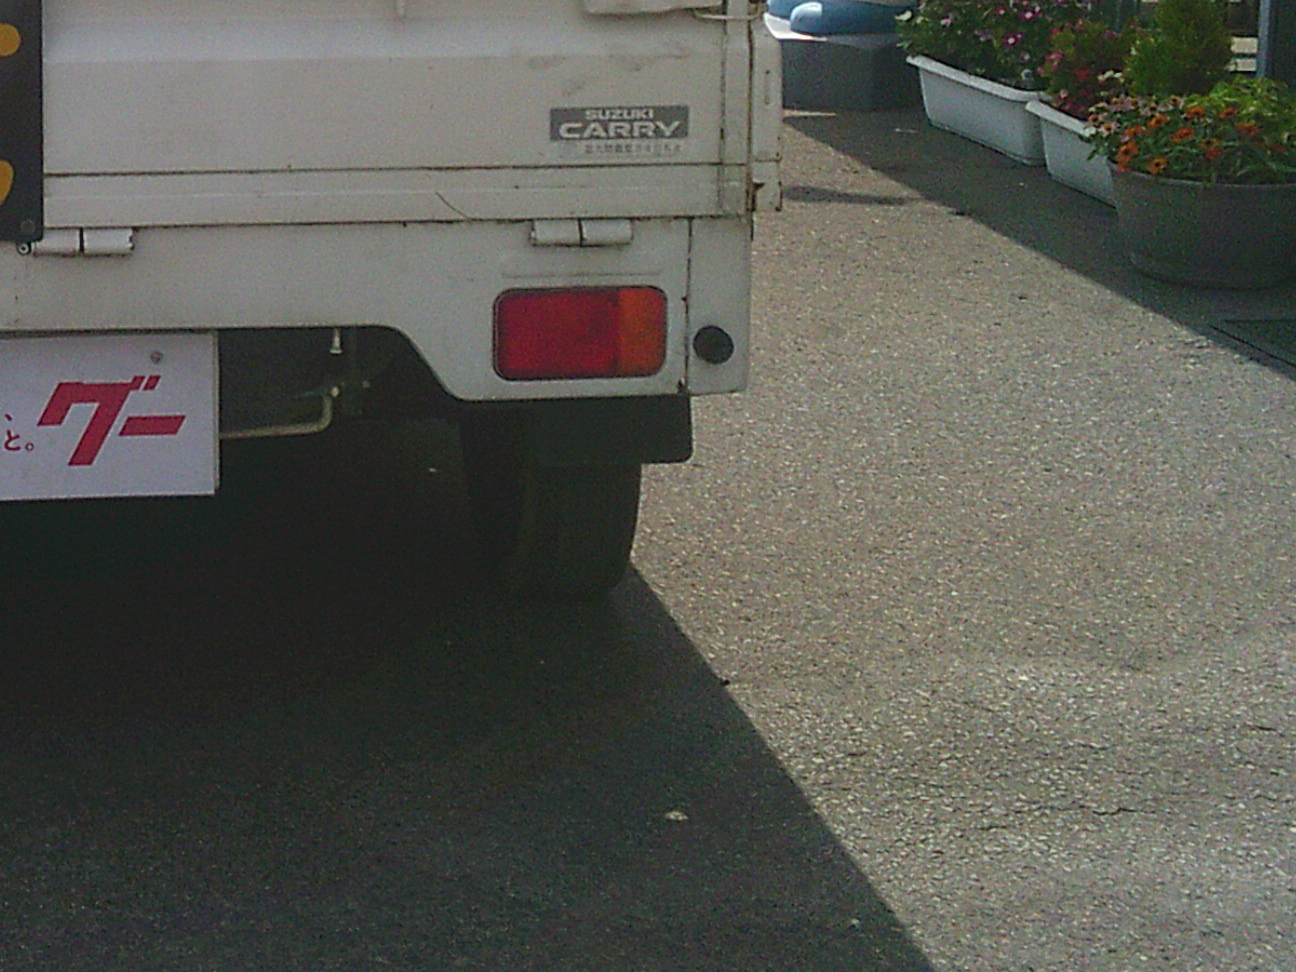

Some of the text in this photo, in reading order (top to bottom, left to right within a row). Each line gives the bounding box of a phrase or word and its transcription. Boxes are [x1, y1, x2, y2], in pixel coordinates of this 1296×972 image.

[585, 108, 654, 120] SUZUKI
[559, 121, 681, 138] CARRY
[37, 375, 186, 466] グー
